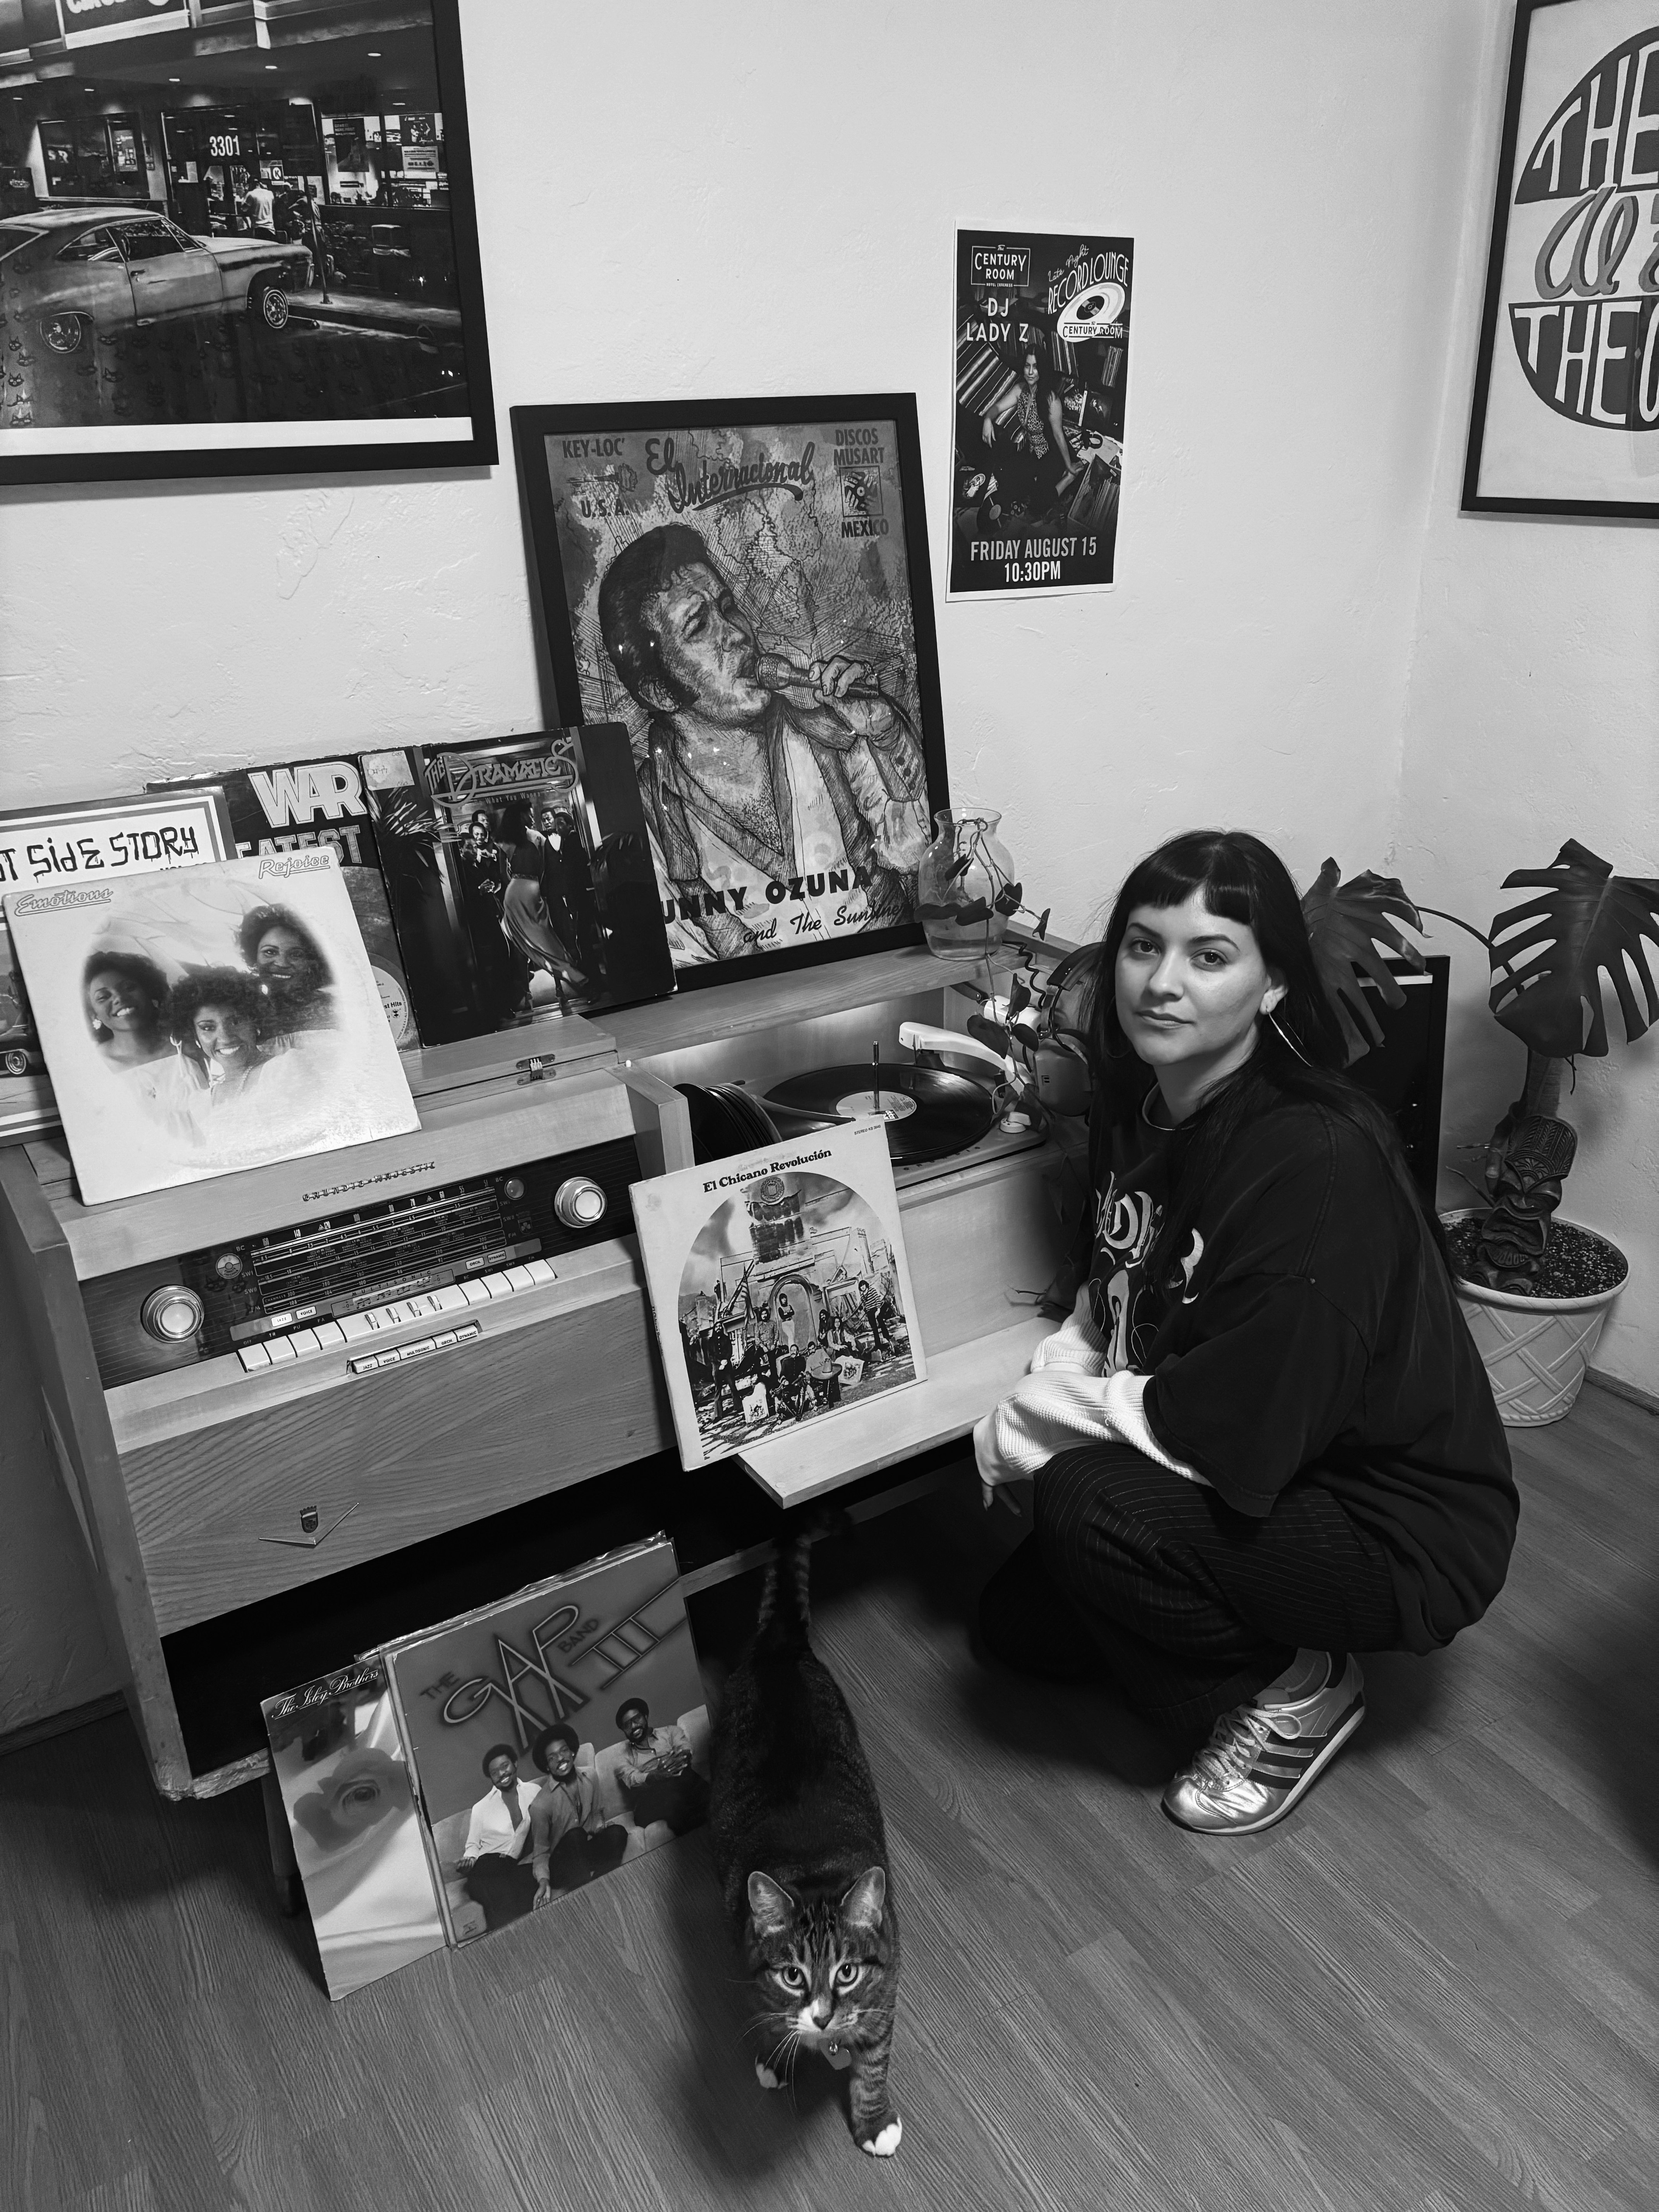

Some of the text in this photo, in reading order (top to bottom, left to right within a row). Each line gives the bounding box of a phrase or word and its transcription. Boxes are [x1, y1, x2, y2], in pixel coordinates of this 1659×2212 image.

[209, 135, 240, 156] 3301
[975, 252, 1027, 271] CENTURY
[986, 268, 1014, 280] ROOM
[1048, 244, 1089, 282] Late Night
[1048, 251, 1129, 315] RECORD LOUNGE
[988, 297, 1008, 317] DJ
[967, 323, 1029, 342] LADY Z
[1063, 326, 1123, 339] CENTURY ROOM
[1514, 301, 1642, 424] THE
[835, 429, 879, 446] DISCOS
[645, 438, 675, 475] El
[833, 447, 884, 465] MUSART
[668, 441, 816, 514] Internacional
[841, 519, 889, 538] MEXICO
[971, 537, 1097, 562] FRIDAY AUGUST 15
[1004, 560, 1061, 582] 10:30PM
[247, 761, 368, 828] WAR
[259, 855, 330, 879] Rejoice
[14, 888, 114, 917] Emotions
[661, 866, 873, 924] UNNY OZUNA
[743, 917, 777, 944] and
[790, 912, 822, 935] The
[703, 1180, 718, 1193] El
[719, 1167, 768, 1188] Chicano
[770, 1148, 832, 1173] Revolución
[407, 1346, 430, 1356] MULTISONIC
[459, 1331, 477, 1340] DYNAMIC
[419, 1671, 461, 1700] THE
[440, 1604, 591, 1754] GAP
[557, 1619, 599, 1653] BAND
[272, 1668, 378, 1717] The Isley Brothers
